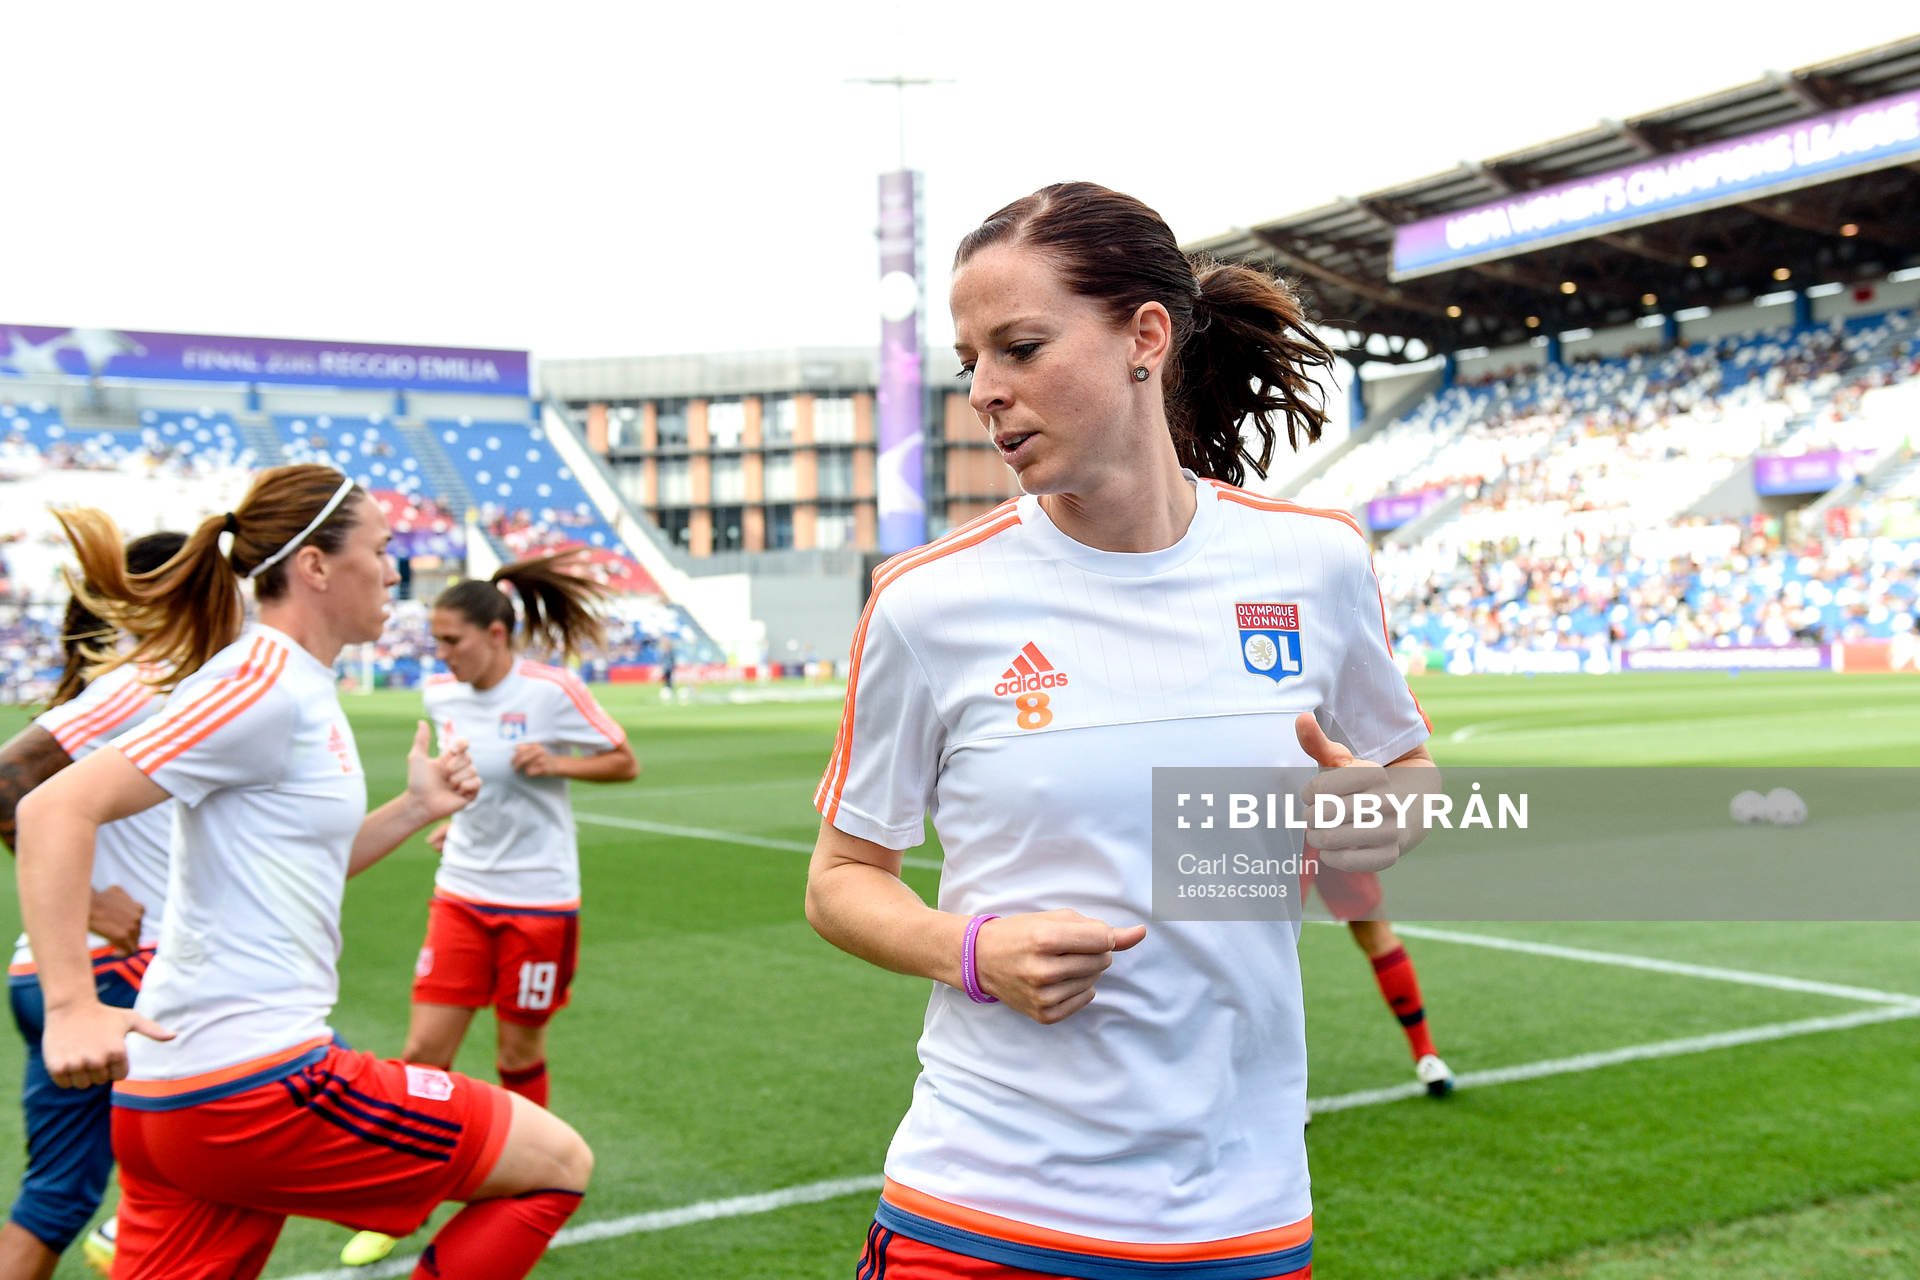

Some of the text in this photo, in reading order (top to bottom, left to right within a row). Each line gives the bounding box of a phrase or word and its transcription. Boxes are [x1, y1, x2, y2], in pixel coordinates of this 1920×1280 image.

[182, 347, 260, 373] FINAL
[418, 355, 500, 384] EMILIA
[1238, 605, 1295, 617] OLYMPIQUE
[1240, 616, 1296, 628] LYONNAIS
[994, 672, 1069, 696] adidas
[1015, 692, 1053, 730] 8
[517, 960, 558, 1010] 19
